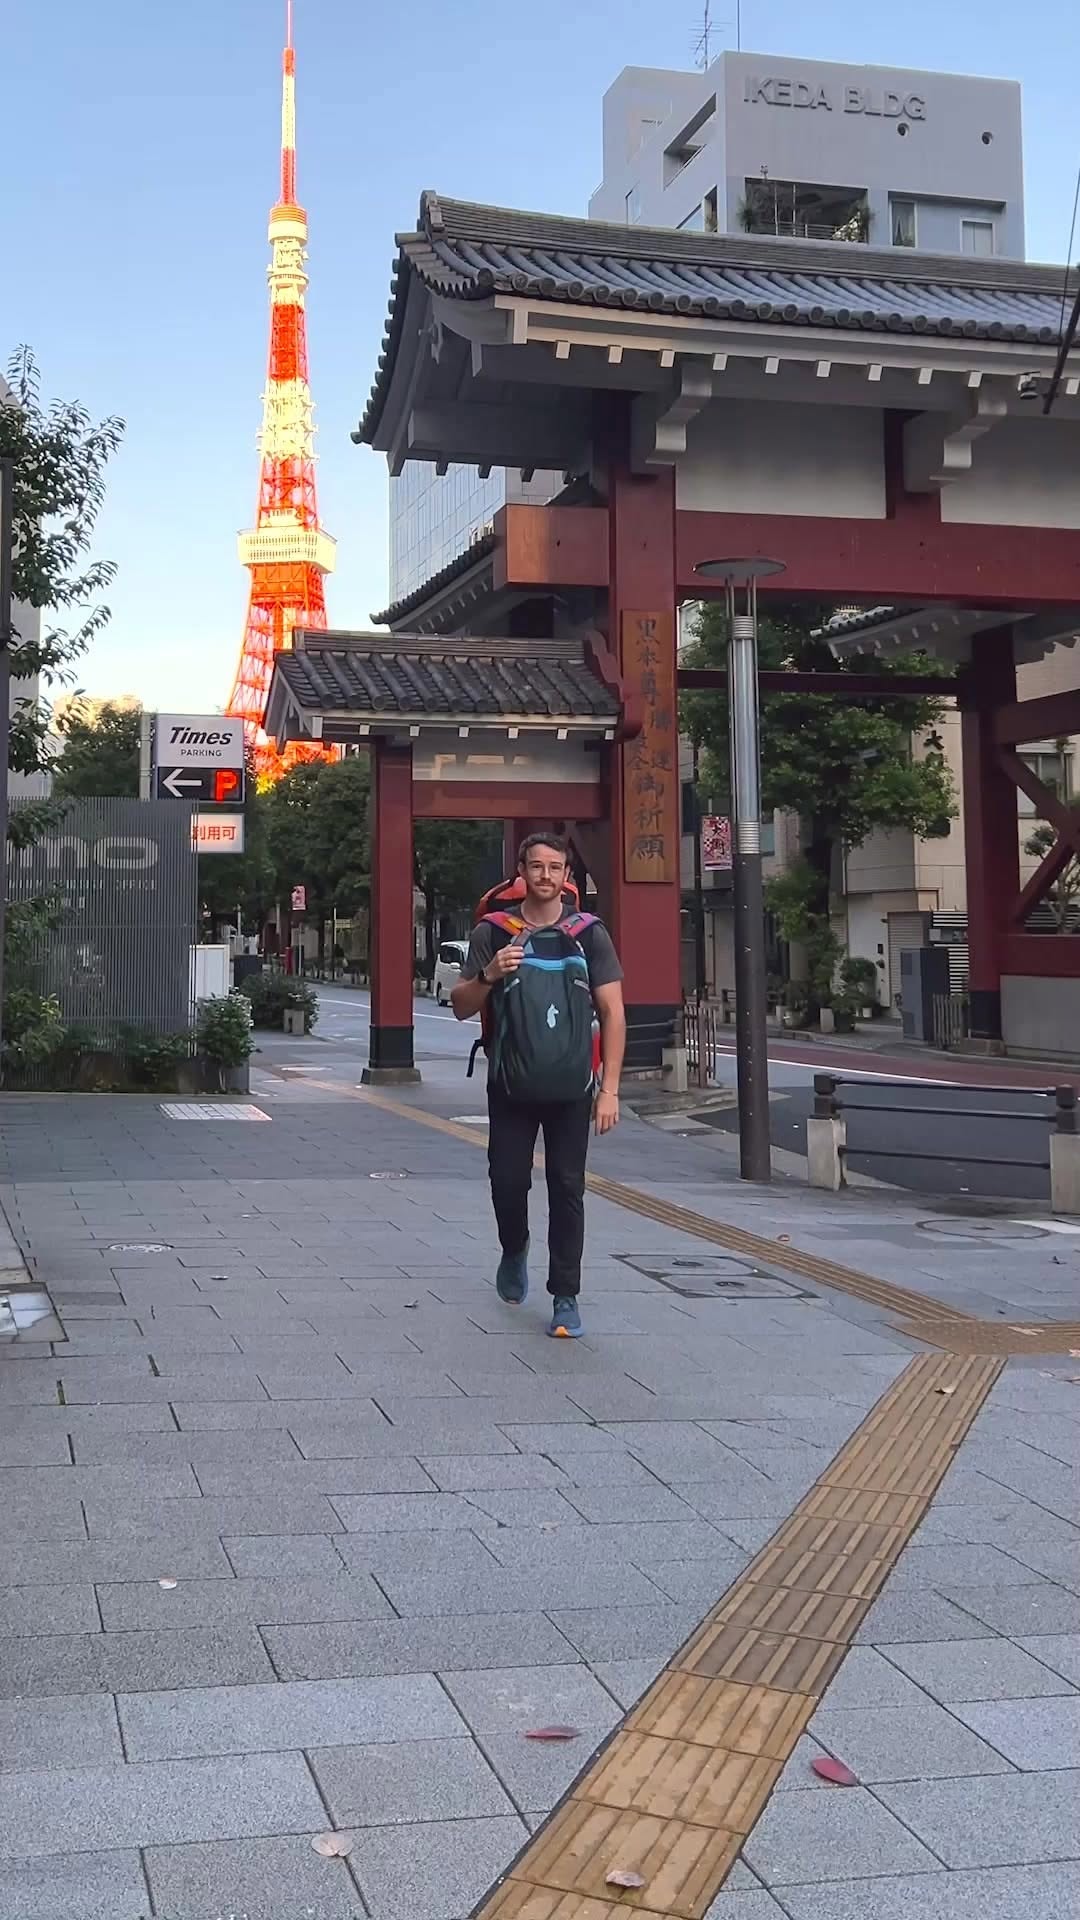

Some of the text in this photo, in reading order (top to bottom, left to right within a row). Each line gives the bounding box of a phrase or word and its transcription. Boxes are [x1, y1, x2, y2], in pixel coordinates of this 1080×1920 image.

[743, 76, 832, 111] IKEDA
[170, 727, 233, 745] Times
[181, 749, 222, 757] PARKING
[215, 769, 238, 803] P
[192, 826, 236, 840] 利用可
